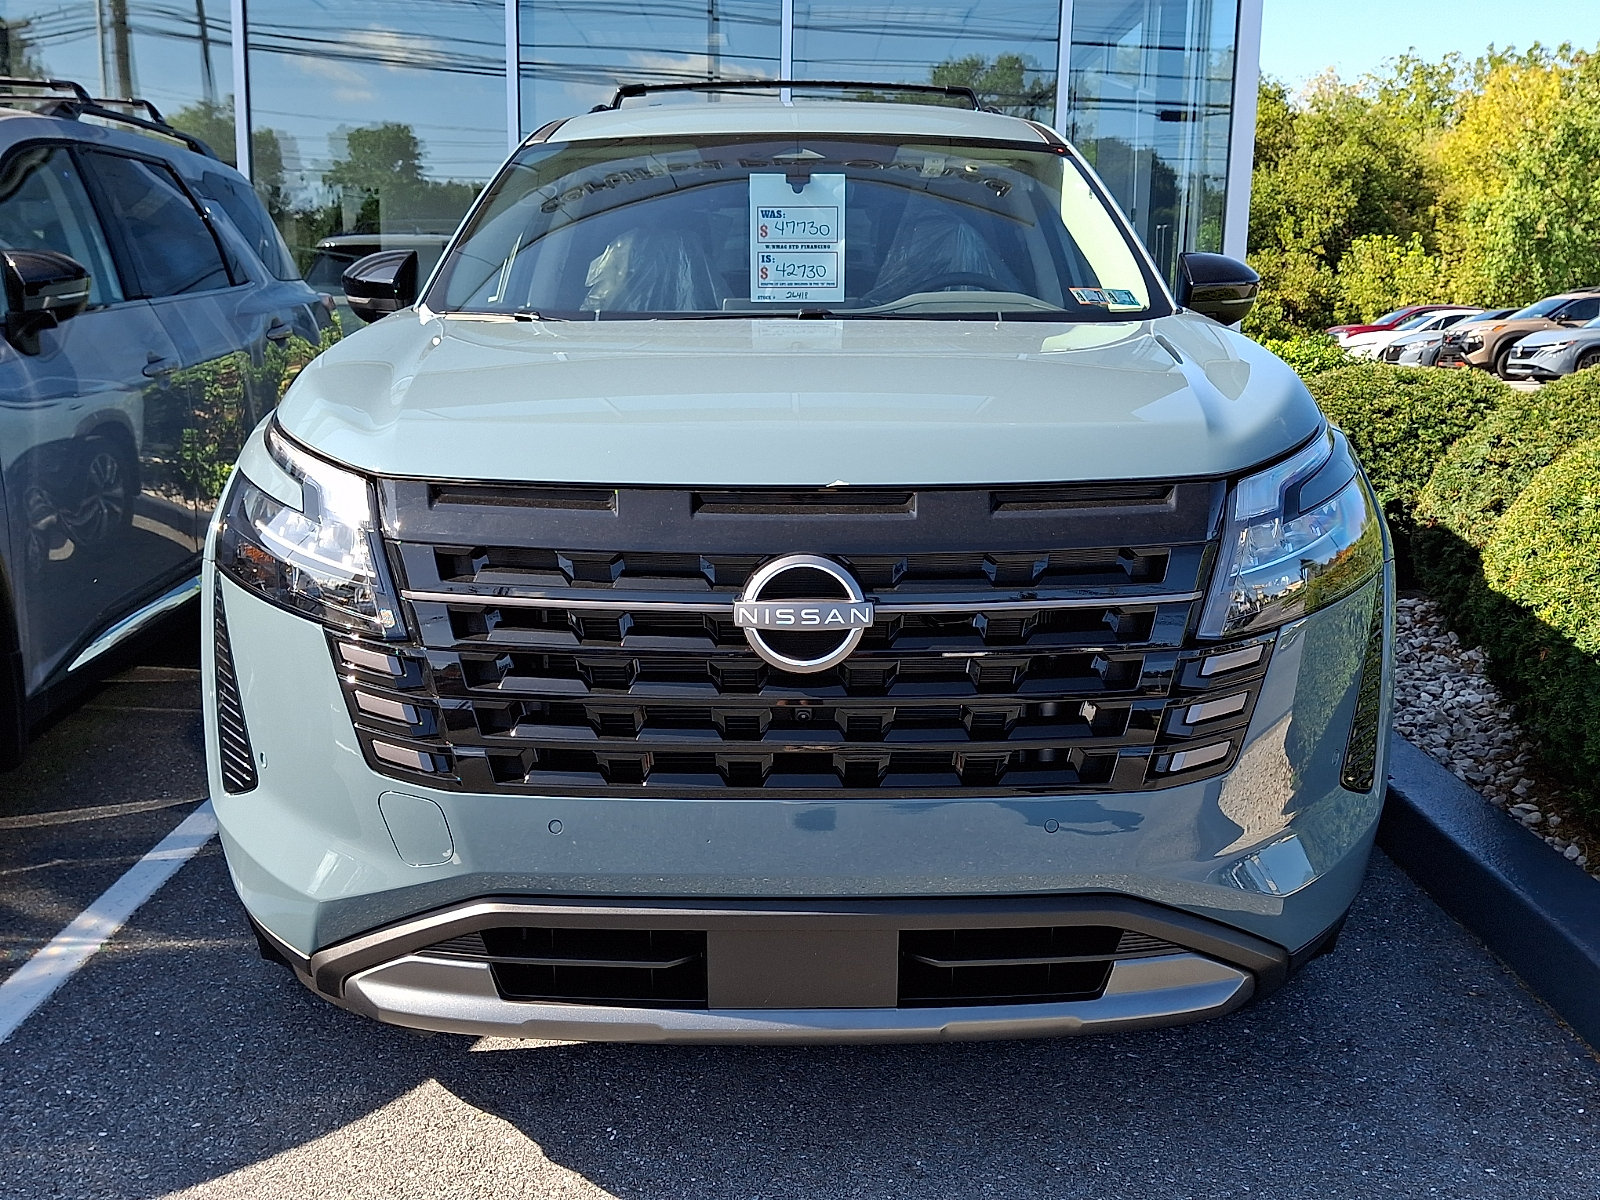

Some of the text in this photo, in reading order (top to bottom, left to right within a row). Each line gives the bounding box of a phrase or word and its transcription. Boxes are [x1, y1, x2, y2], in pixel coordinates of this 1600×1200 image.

[760, 210, 786, 219] WAS:
[760, 220, 831, 238] $ 47730
[761, 254, 775, 263] IS:
[760, 262, 827, 280] $ 42730
[738, 607, 869, 625] NISSAN
